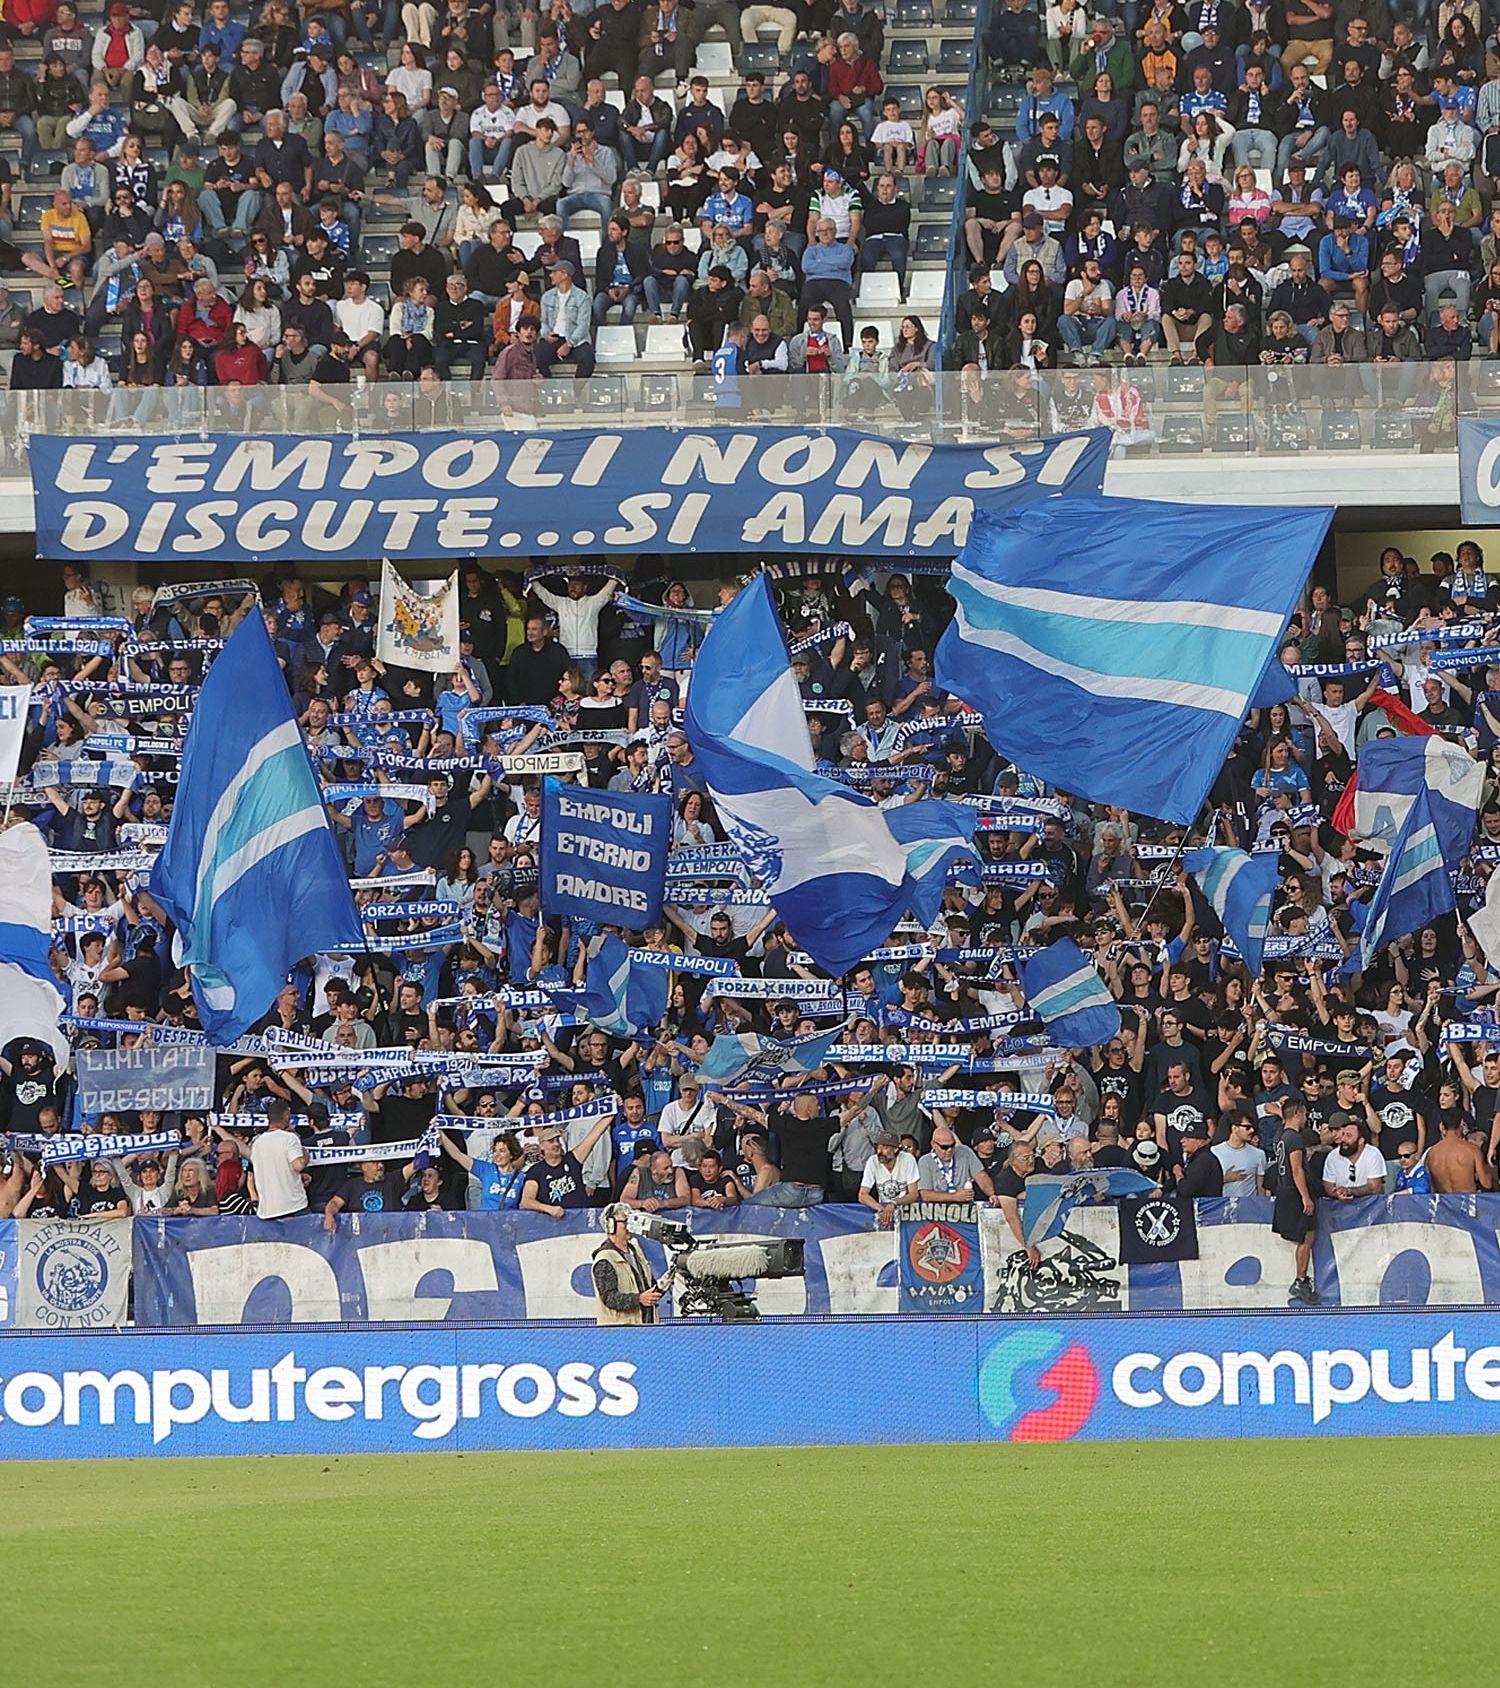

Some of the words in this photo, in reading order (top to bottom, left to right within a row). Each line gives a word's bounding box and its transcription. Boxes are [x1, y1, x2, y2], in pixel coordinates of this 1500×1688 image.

[715, 357, 725, 384] 3
[54, 434, 622, 494] L'EMPOLI
[661, 434, 931, 491] NON
[965, 434, 1091, 490] SI
[741, 491, 974, 549] AMA
[126, 640, 170, 657] ORZA
[173, 638, 225, 651] EMPOL
[1284, 663, 1345, 677] MPOLI
[61, 680, 119, 694] FORZA
[124, 682, 188, 696] EMPOLI
[129, 697, 190, 714] EMPOLI
[377, 751, 425, 771] FORZA
[428, 754, 484, 771] EMPOLI
[558, 796, 653, 835] EMPOLI
[557, 831, 652, 873] ETERNO
[692, 859, 736, 875] EMPOLI
[555, 873, 649, 913] AMORE
[408, 902, 460, 917] EMPOLI
[629, 949, 671, 967] FORZA
[674, 955, 728, 974] EMPOLI
[717, 980, 759, 995] FORZA
[777, 981, 826, 995] EMPOLI
[968, 1008, 1035, 1030] EMPOLI
[1287, 1035, 1352, 1056] EMPOLI
[86, 1046, 207, 1072] LIMITATI
[374, 1061, 423, 1082] EMPOLI
[82, 1086, 212, 1113] PRESENTI
[925, 1088, 975, 1101] ESPE
[44, 1130, 180, 1158] ESPERADOS
[24, 1223, 122, 1258] DIFFIDATI
[35, 1305, 72, 1328] CON
[77, 1303, 112, 1328] NOI
